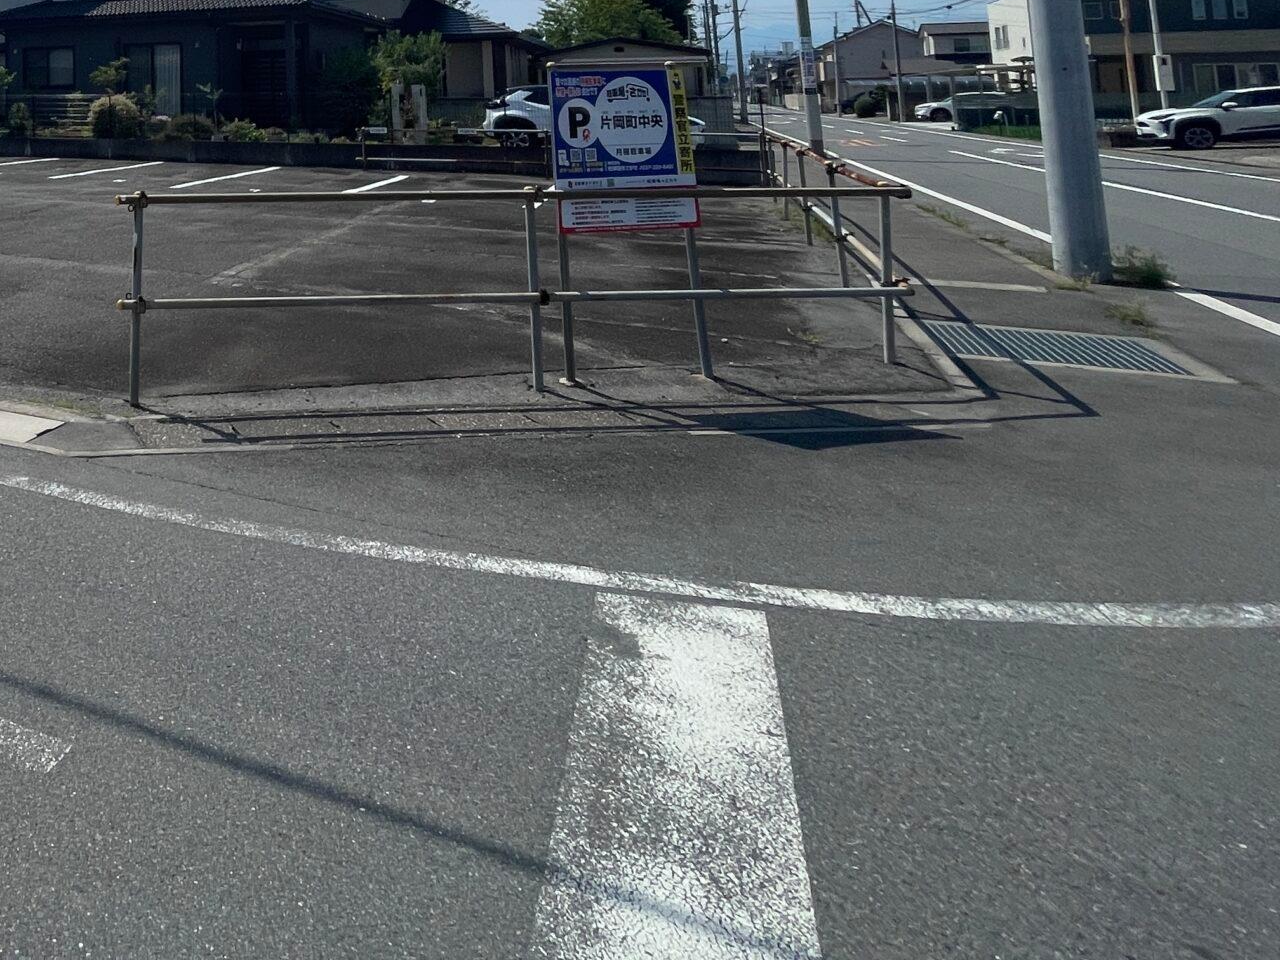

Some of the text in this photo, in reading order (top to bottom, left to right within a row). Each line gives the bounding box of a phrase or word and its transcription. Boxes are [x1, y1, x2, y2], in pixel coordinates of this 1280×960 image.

[568, 106, 590, 138] P
[600, 114, 663, 130] 片岡町中央
